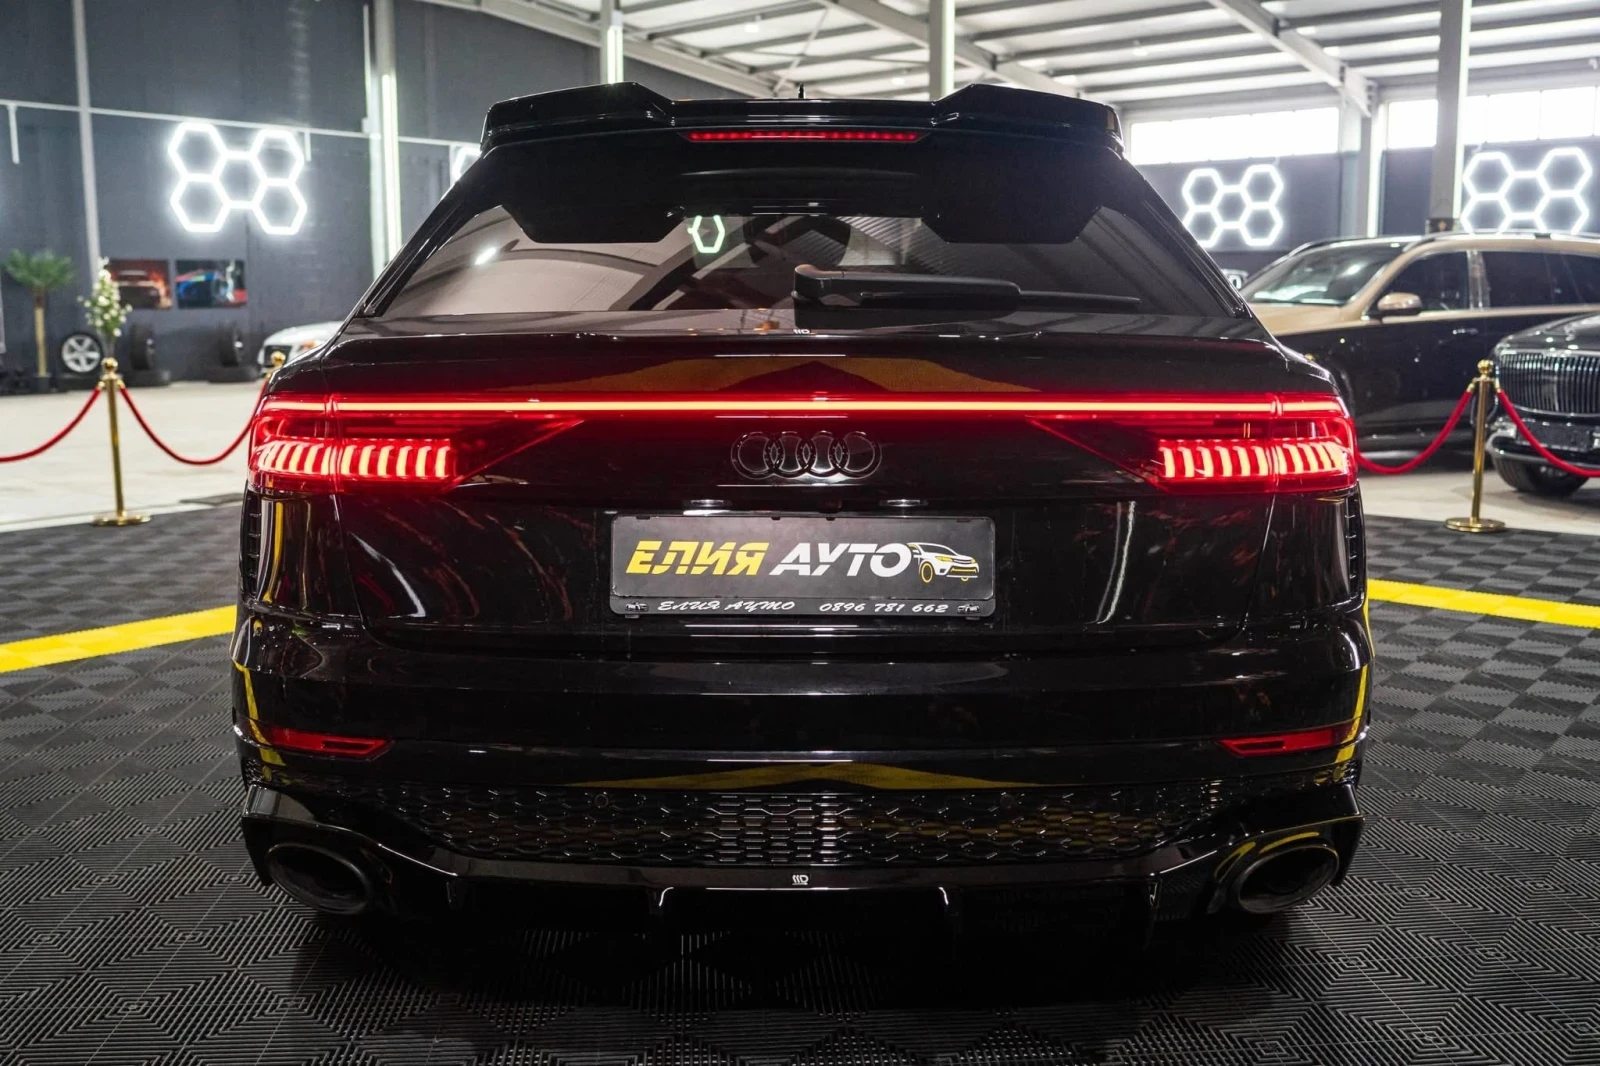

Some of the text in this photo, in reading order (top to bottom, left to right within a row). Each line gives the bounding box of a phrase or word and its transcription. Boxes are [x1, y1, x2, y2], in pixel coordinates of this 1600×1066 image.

[625, 540, 912, 578] ЕЛИЯ АУТО
[818, 602, 949, 613] 0896 781 662
